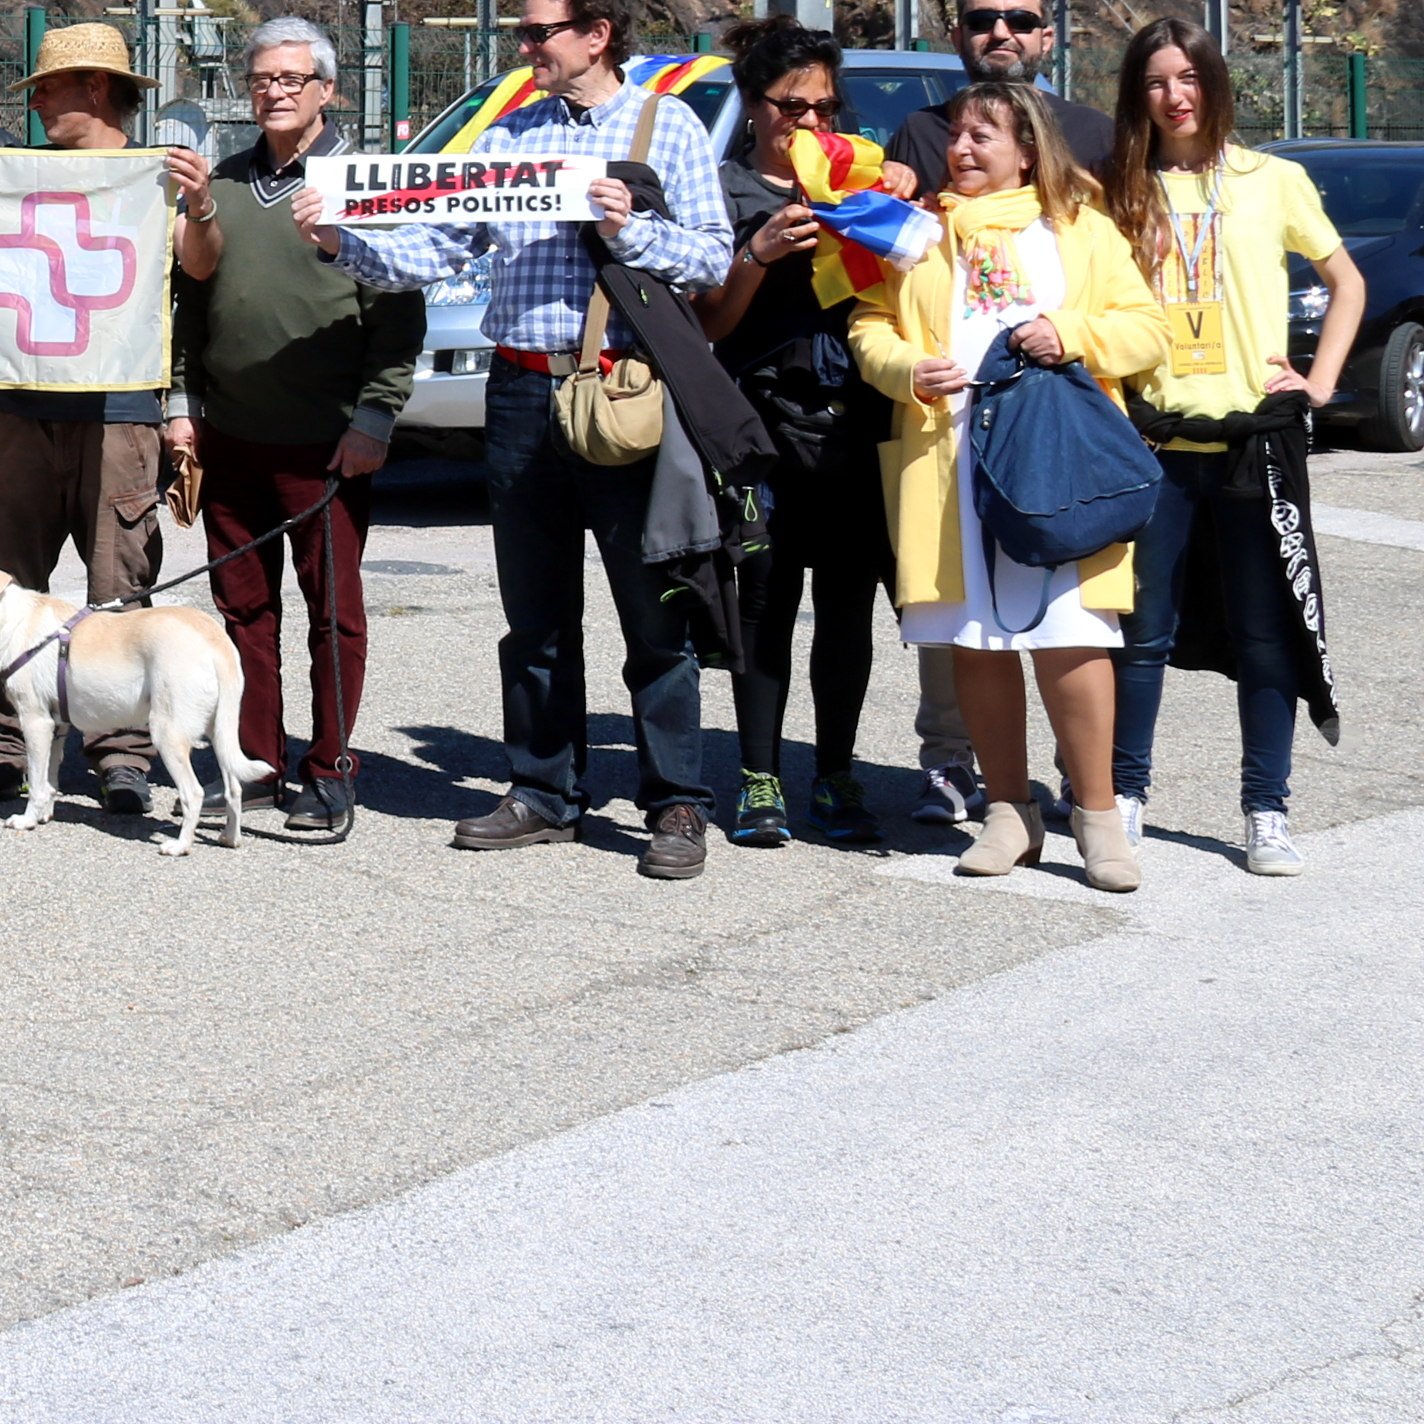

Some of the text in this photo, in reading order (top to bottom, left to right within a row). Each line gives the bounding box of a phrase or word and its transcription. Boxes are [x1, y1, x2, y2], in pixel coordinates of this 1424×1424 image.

[345, 161, 563, 191] LLIBERTAT
[345, 191, 562, 214] PRESOS POLÍTICS!
[1185, 311, 1204, 339] V
